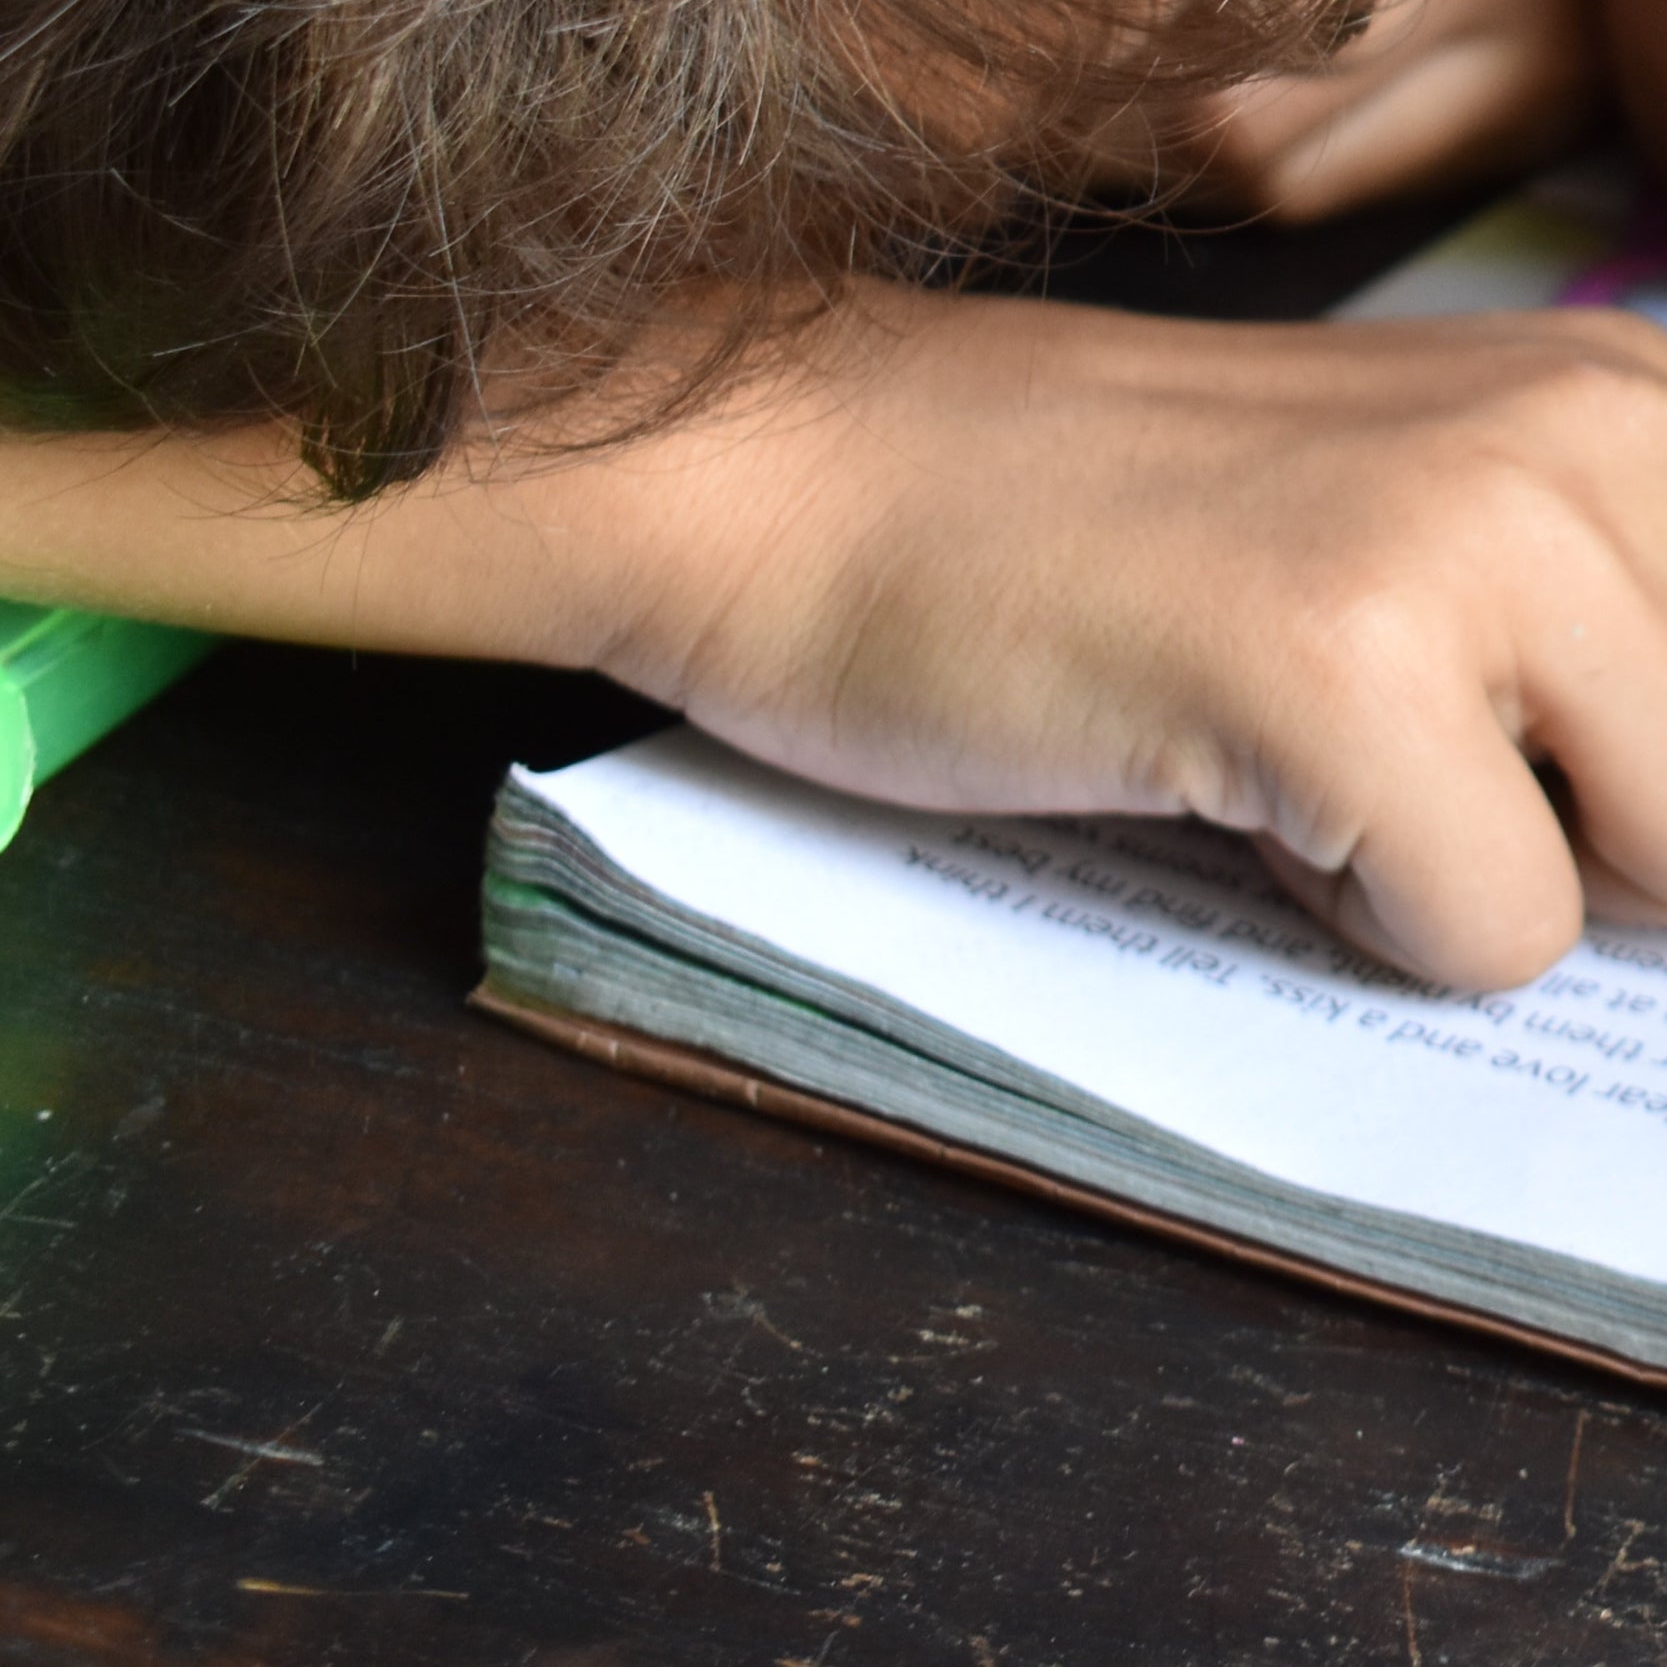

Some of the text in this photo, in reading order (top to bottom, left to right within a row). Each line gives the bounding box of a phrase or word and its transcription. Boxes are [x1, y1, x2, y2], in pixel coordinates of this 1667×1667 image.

[947, 820, 1051, 877] best
[902, 844, 1010, 903] think
[1053, 862, 1126, 900] my
[1040, 902, 1159, 955] them
[1120, 888, 1218, 934] find
[1158, 946, 1237, 987] Tell
[1216, 919, 1315, 968] and
[1262, 974, 1345, 1024] kiss.
[1538, 961, 1600, 999] all
[1604, 989, 1657, 1015] at
[1385, 1023, 1484, 1059] and
[1522, 1012, 1645, 1063] them
[1488, 1050, 1590, 1097] love
